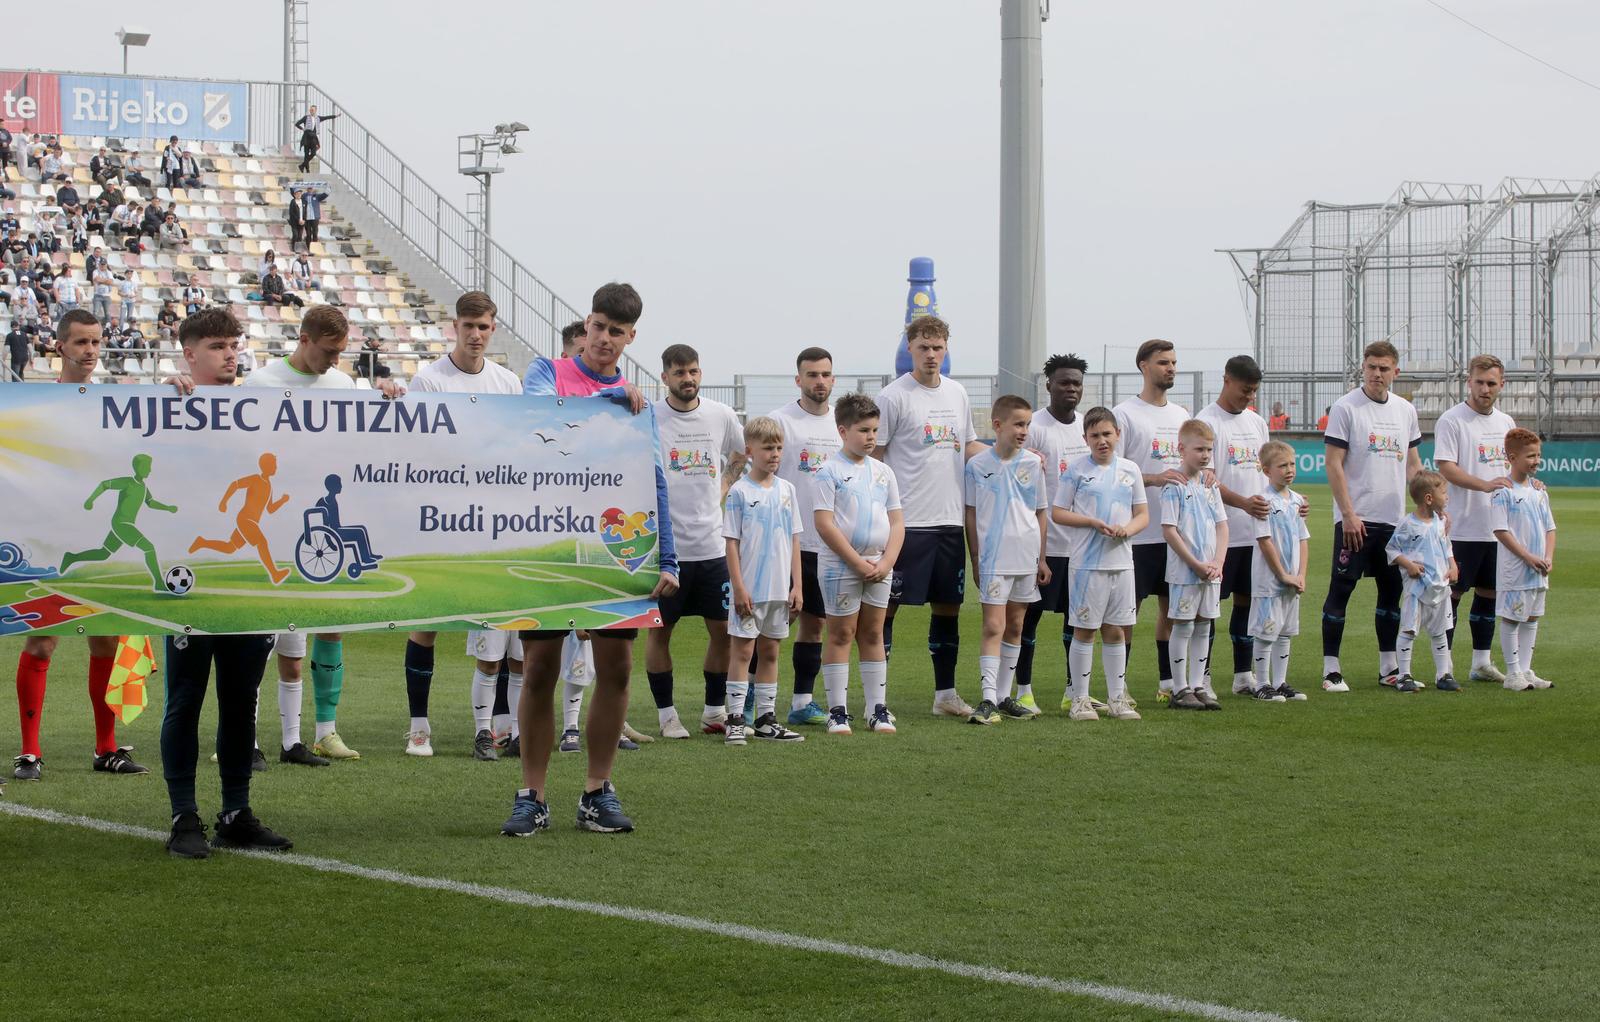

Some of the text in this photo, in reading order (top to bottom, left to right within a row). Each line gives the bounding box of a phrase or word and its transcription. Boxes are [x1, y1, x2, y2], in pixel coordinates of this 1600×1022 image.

[3, 87, 189, 131] te Rijeko
[102, 396, 458, 437] MJESEC AUTIZMA
[352, 463, 624, 492] Mali koraci, velike promjene
[1295, 453, 1326, 472] OP
[419, 504, 597, 540] Budi podrška
